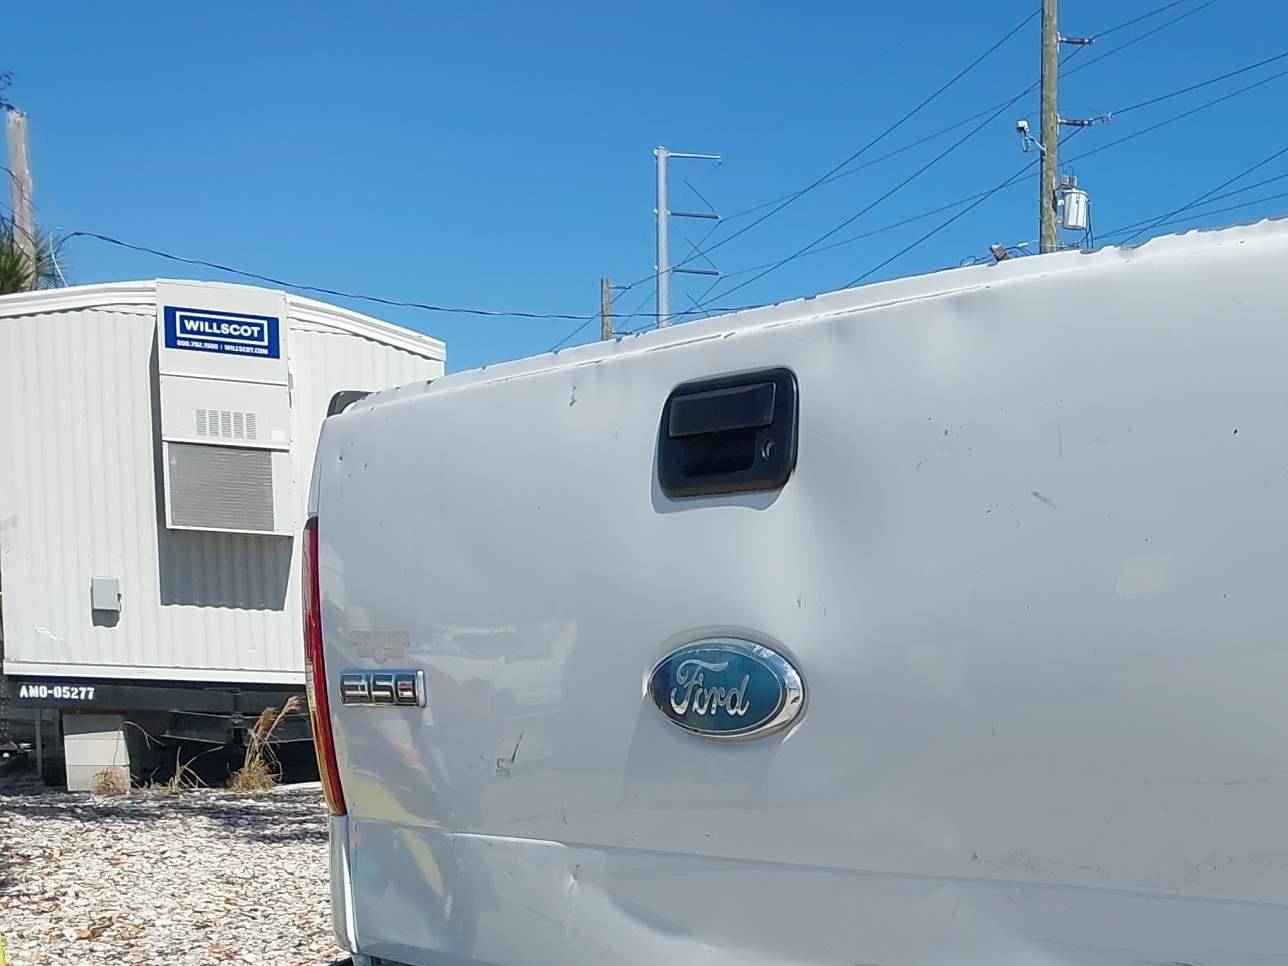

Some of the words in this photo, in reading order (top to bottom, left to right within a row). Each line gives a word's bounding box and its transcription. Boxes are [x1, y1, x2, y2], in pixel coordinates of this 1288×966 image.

[183, 318, 261, 338] WILLSCOT
[19, 684, 95, 700] AMO-05277
[670, 659, 750, 716] Ford
